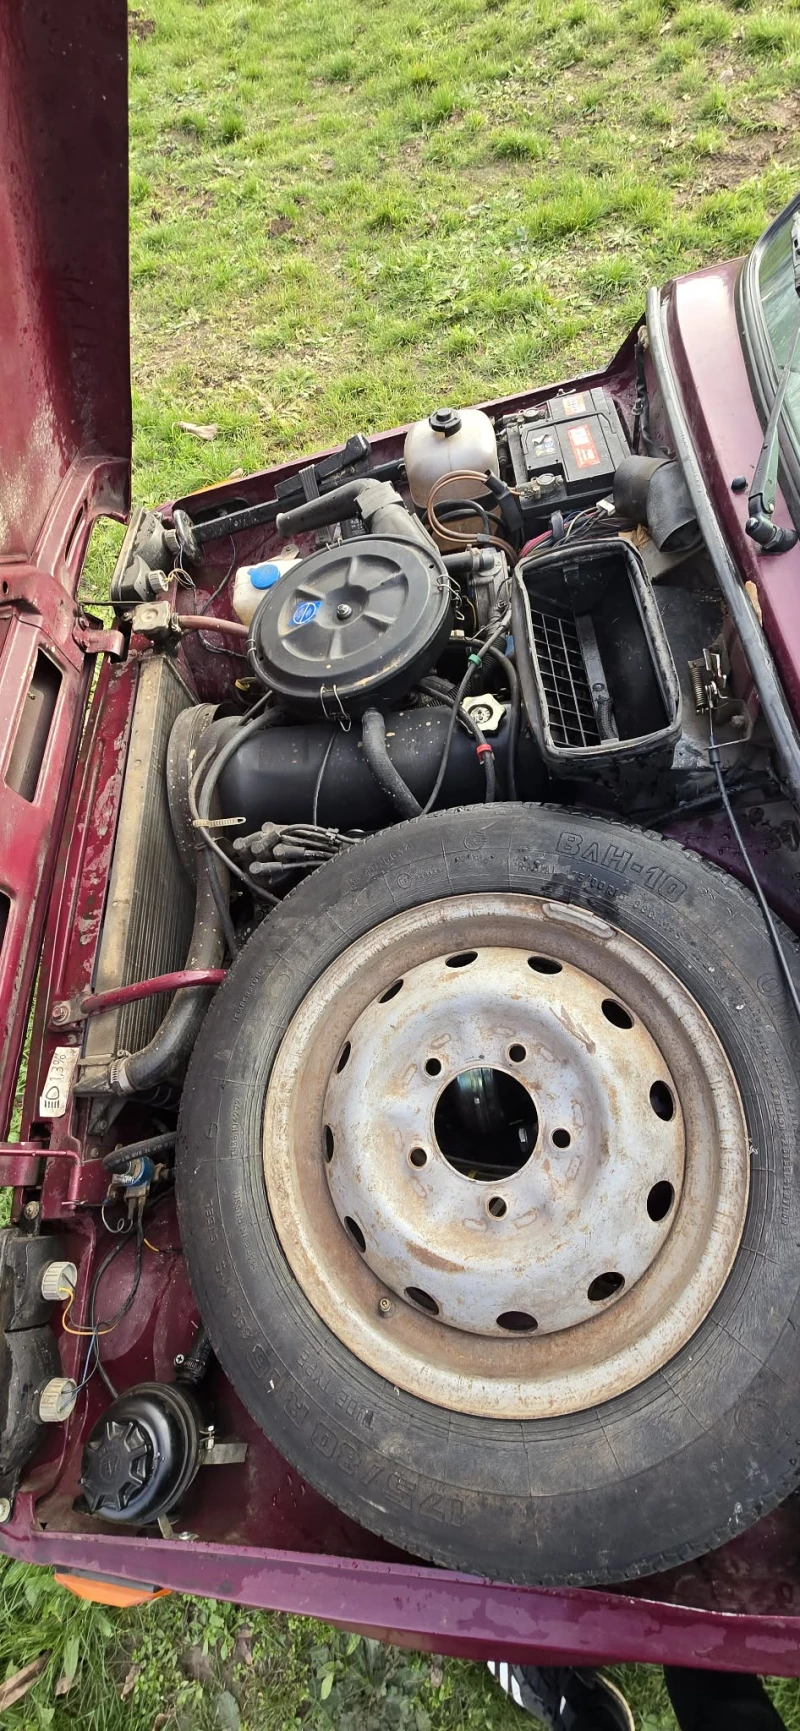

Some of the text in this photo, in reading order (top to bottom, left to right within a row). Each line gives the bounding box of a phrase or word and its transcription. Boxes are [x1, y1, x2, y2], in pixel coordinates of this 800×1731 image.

[49, 1053, 66, 1081] 1,3%
[204, 1198, 218, 1244] STEEL
[297, 1348, 334, 1396] TYPE
[311, 1419, 466, 1528] 175/80
